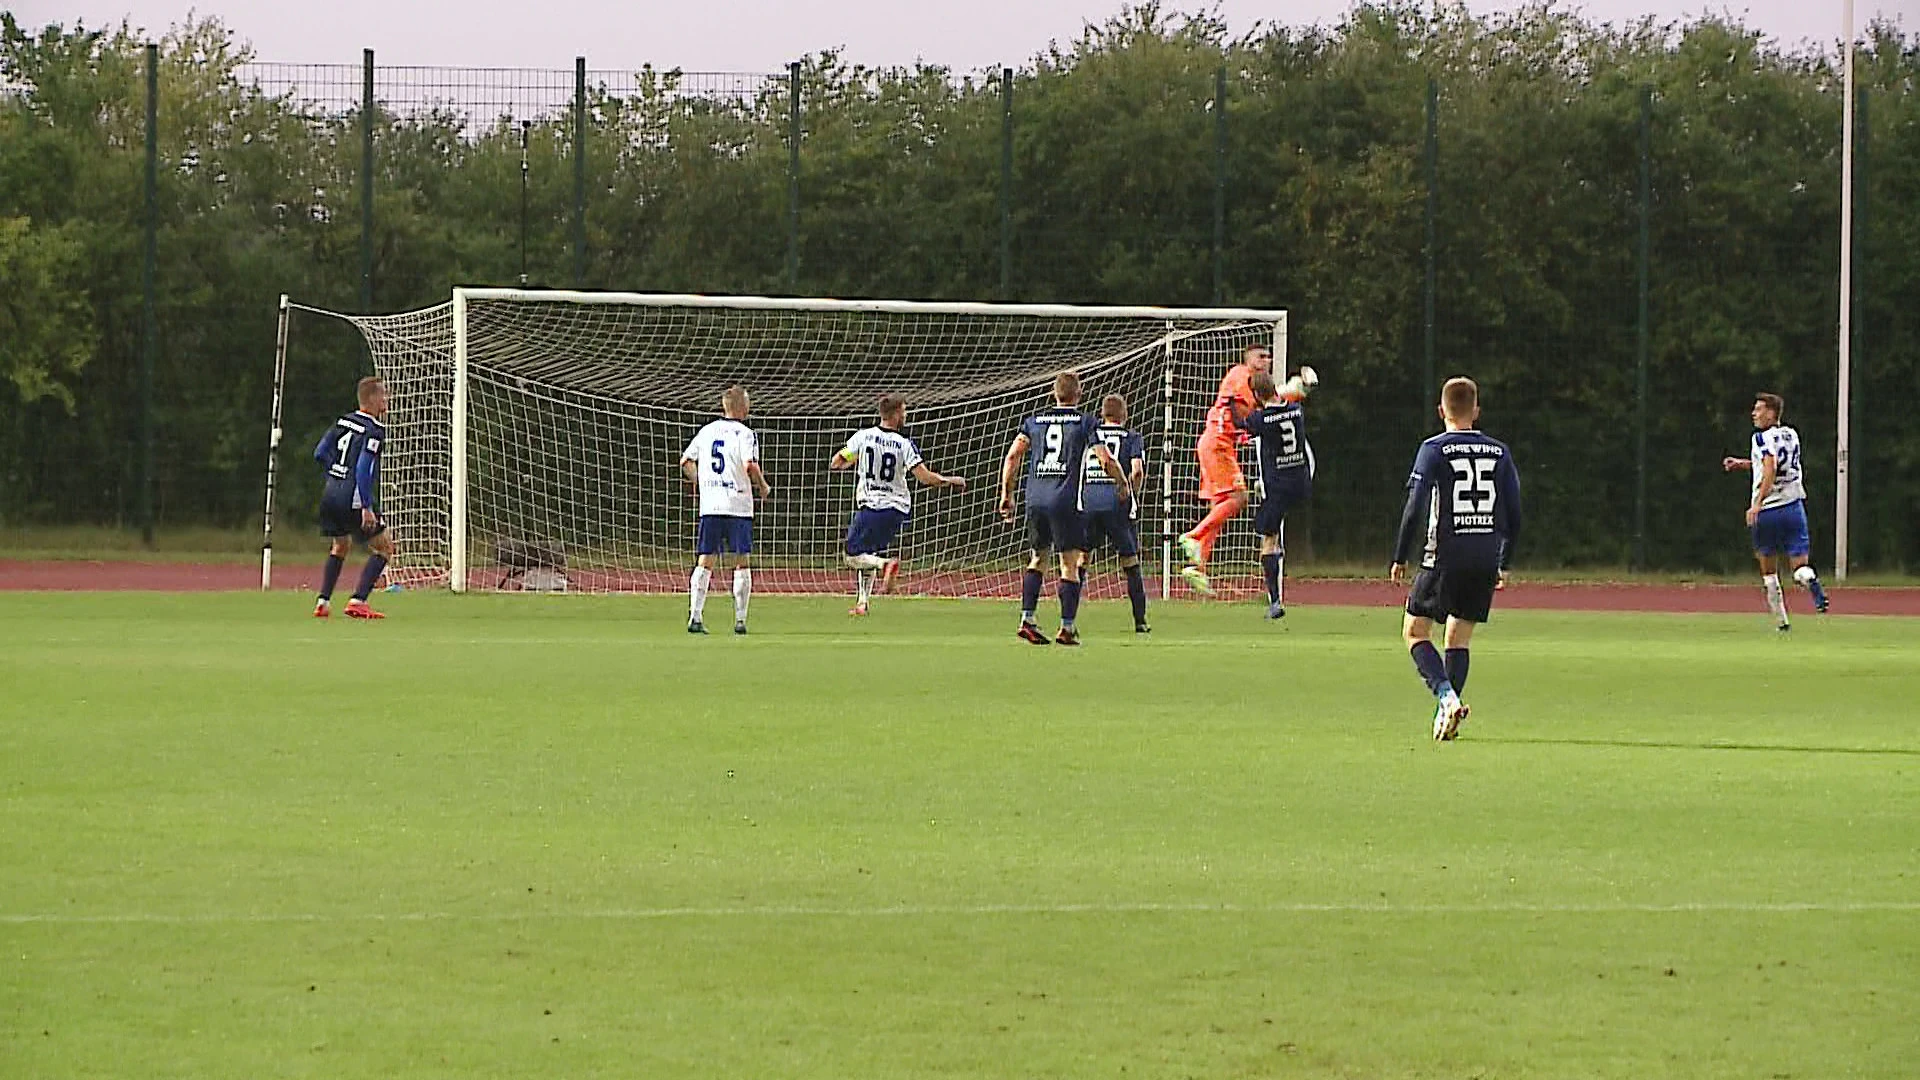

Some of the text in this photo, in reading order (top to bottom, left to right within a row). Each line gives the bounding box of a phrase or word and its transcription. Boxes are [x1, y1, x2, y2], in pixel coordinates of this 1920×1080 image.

[338, 430, 353, 465] 4
[1045, 424, 1063, 462] 9
[1280, 420, 1297, 454] 3
[712, 440, 725, 474] 5
[866, 446, 896, 482] 18
[1449, 458, 1497, 513] 25
[1454, 515, 1494, 526] PIOTREX
